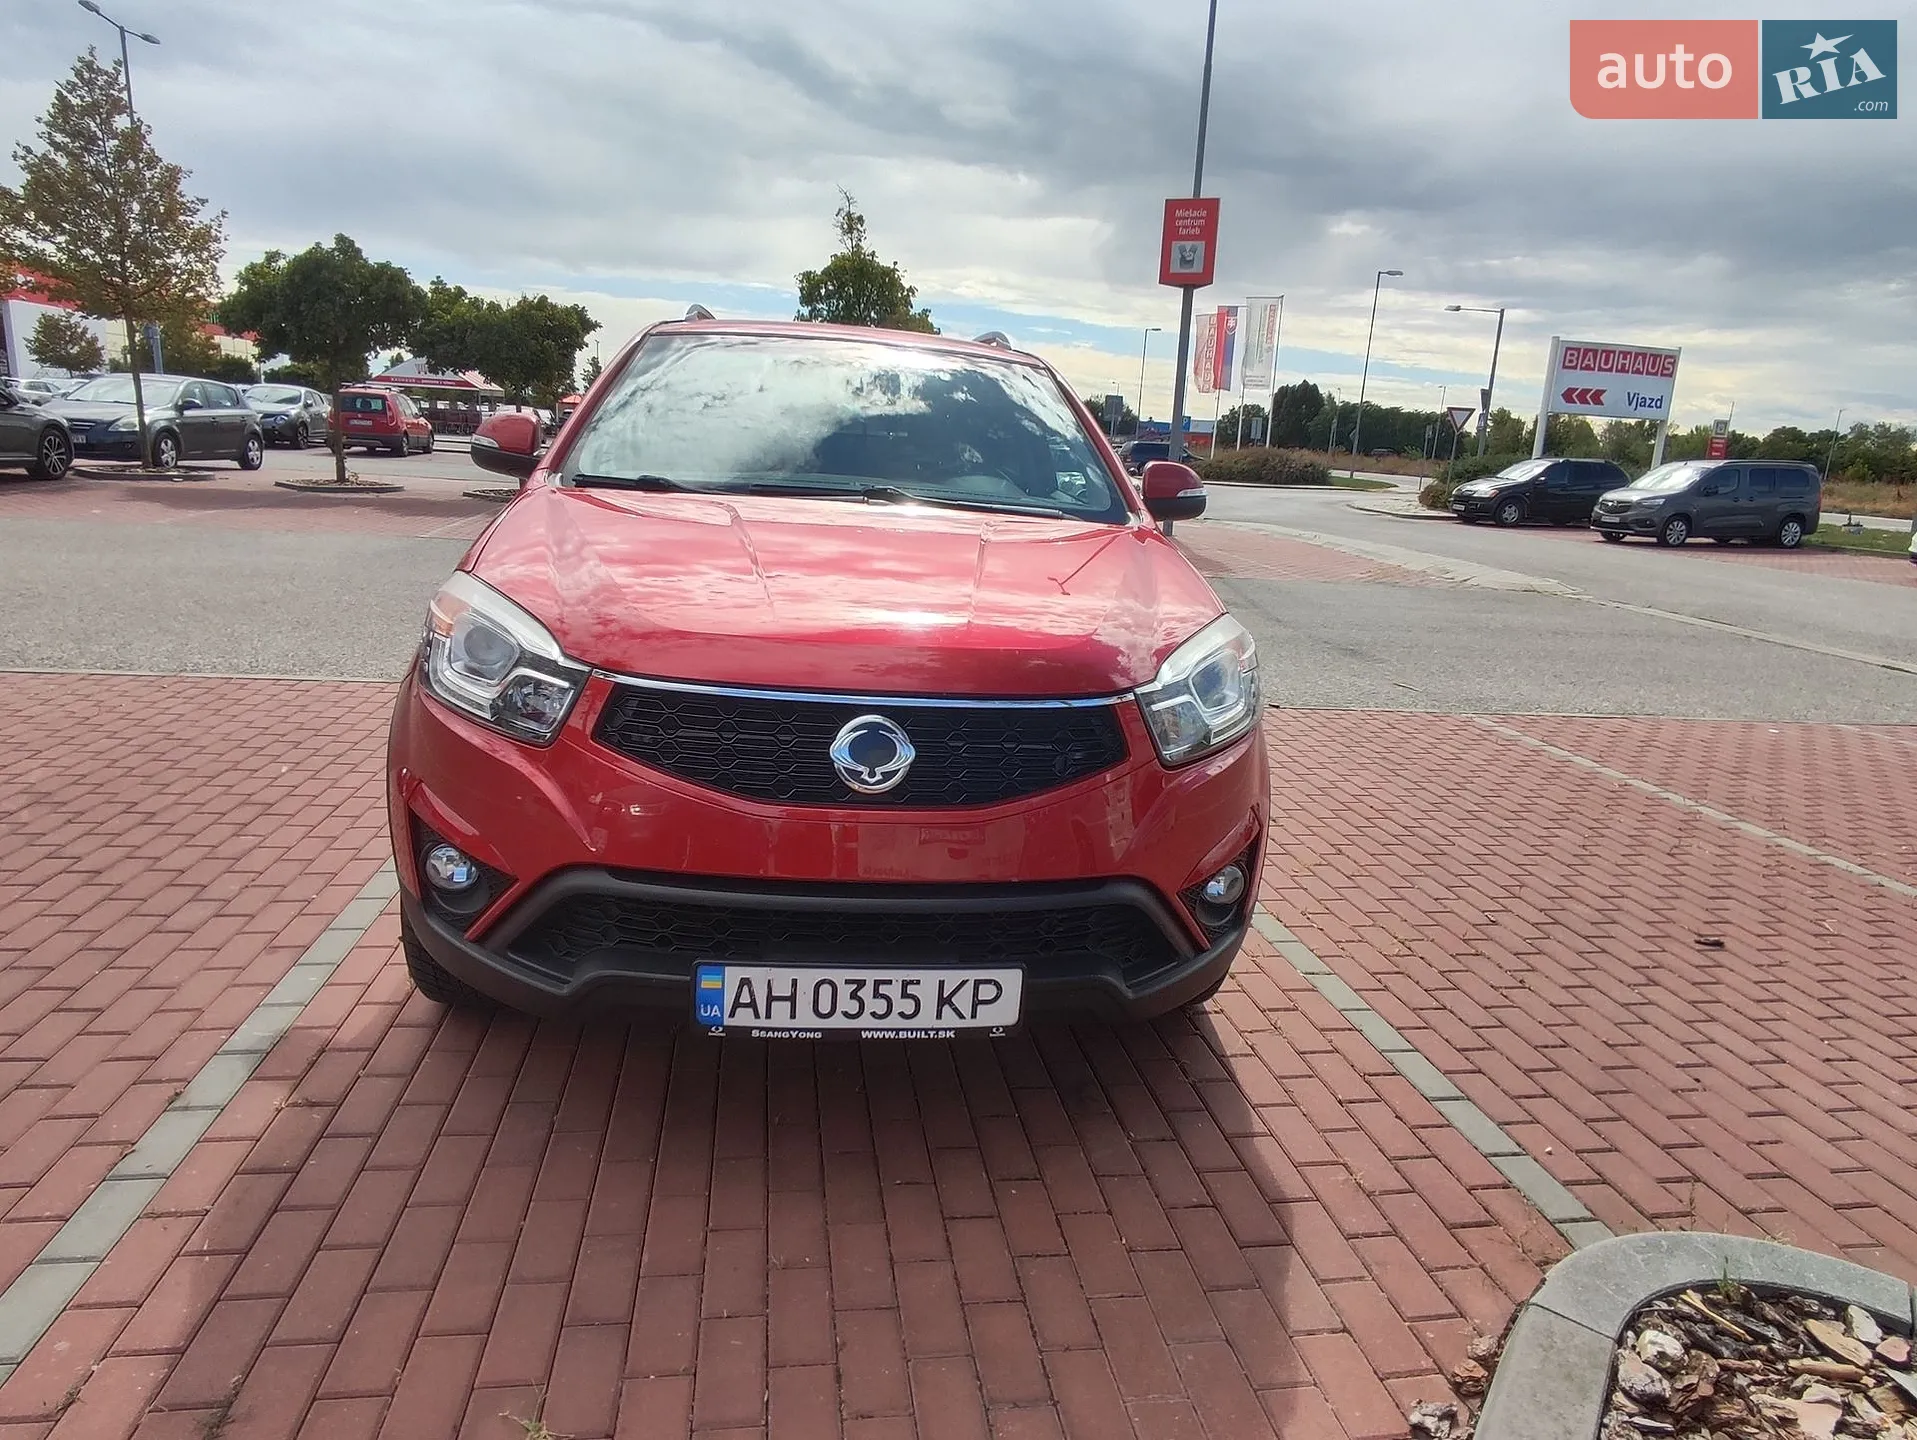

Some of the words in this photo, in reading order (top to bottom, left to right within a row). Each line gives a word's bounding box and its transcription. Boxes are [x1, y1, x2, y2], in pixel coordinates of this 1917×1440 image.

[1175, 218, 1205, 226] centrum
[1563, 348, 1676, 376] BAUHAUS
[1626, 391, 1664, 411] Vjazd
[728, 977, 798, 1020] AH
[812, 978, 922, 1020] 0355
[935, 978, 1003, 1020] KP
[700, 1004, 721, 1017] UA
